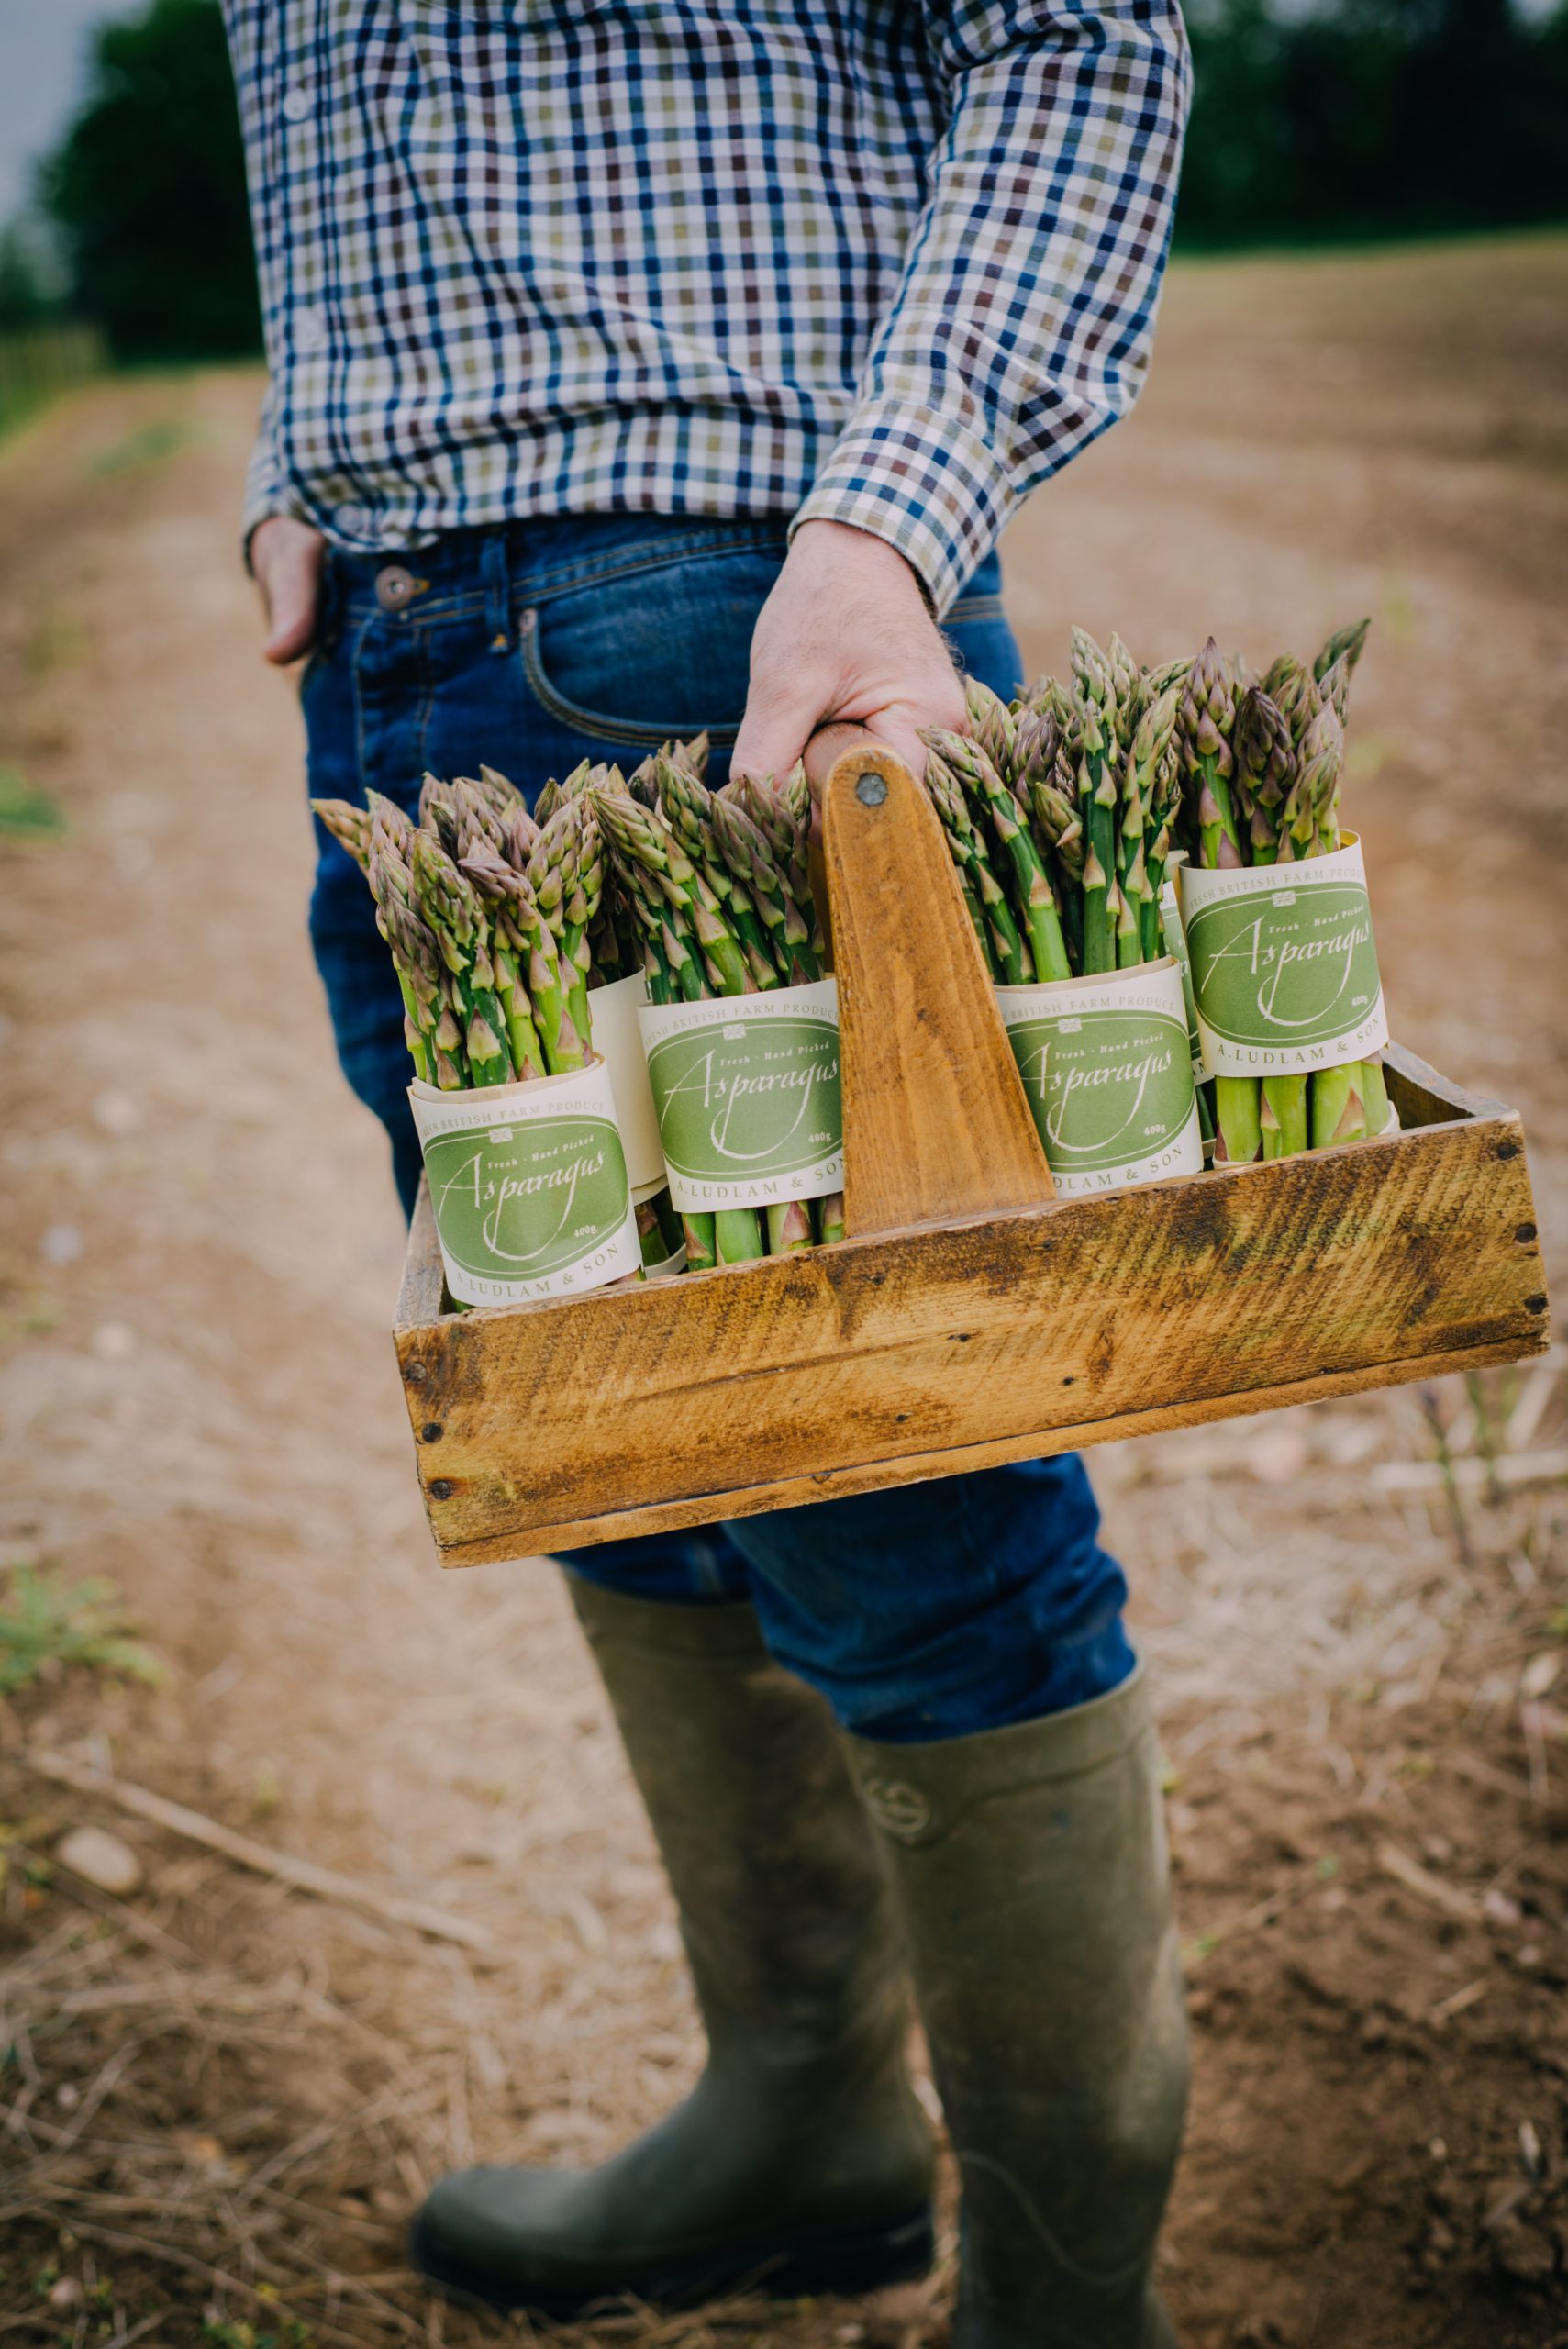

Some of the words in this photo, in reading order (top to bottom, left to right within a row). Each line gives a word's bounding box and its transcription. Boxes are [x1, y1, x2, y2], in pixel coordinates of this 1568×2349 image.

[1218, 876, 1276, 896] BRITISH
[1284, 870, 1323, 883] FARM
[1269, 923, 1299, 934] Fresh
[1314, 913, 1338, 927] Hand
[1200, 915, 1370, 1026] Asparagus
[673, 1009, 726, 1030] BRITISH
[733, 1004, 775, 1016] FARM
[1010, 1003, 1062, 1020] BRITISH
[1070, 997, 1111, 1009] FARM
[1118, 996, 1174, 1010] PRODUCE
[720, 1055, 750, 1066] Fresh
[765, 1049, 792, 1060] Hand
[798, 1041, 829, 1055] Picked
[1056, 1049, 1085, 1060] Fresh
[1100, 1041, 1128, 1054] Hand
[1133, 1032, 1164, 1047] Picked
[1337, 1041, 1349, 1052] &
[661, 1048, 839, 1160] Asparagus
[1019, 1041, 1173, 1152] Asparagus
[440, 1112, 492, 1130] BRITISH
[500, 1105, 541, 1119] FARM
[548, 1100, 604, 1112] PRODUCE
[808, 1132, 832, 1144] 400g
[1143, 1123, 1167, 1136] 400g
[488, 1159, 517, 1170] Fresh
[532, 1147, 559, 1161] Hand
[563, 1135, 595, 1152] Picked
[1126, 1168, 1139, 1181] &
[1150, 1144, 1183, 1173] SON
[792, 1176, 803, 1188] &
[438, 1150, 605, 1261] Asparagus
[573, 1225, 597, 1238] 400g
[562, 1273, 573, 1285] &
[583, 1243, 619, 1275] SON
